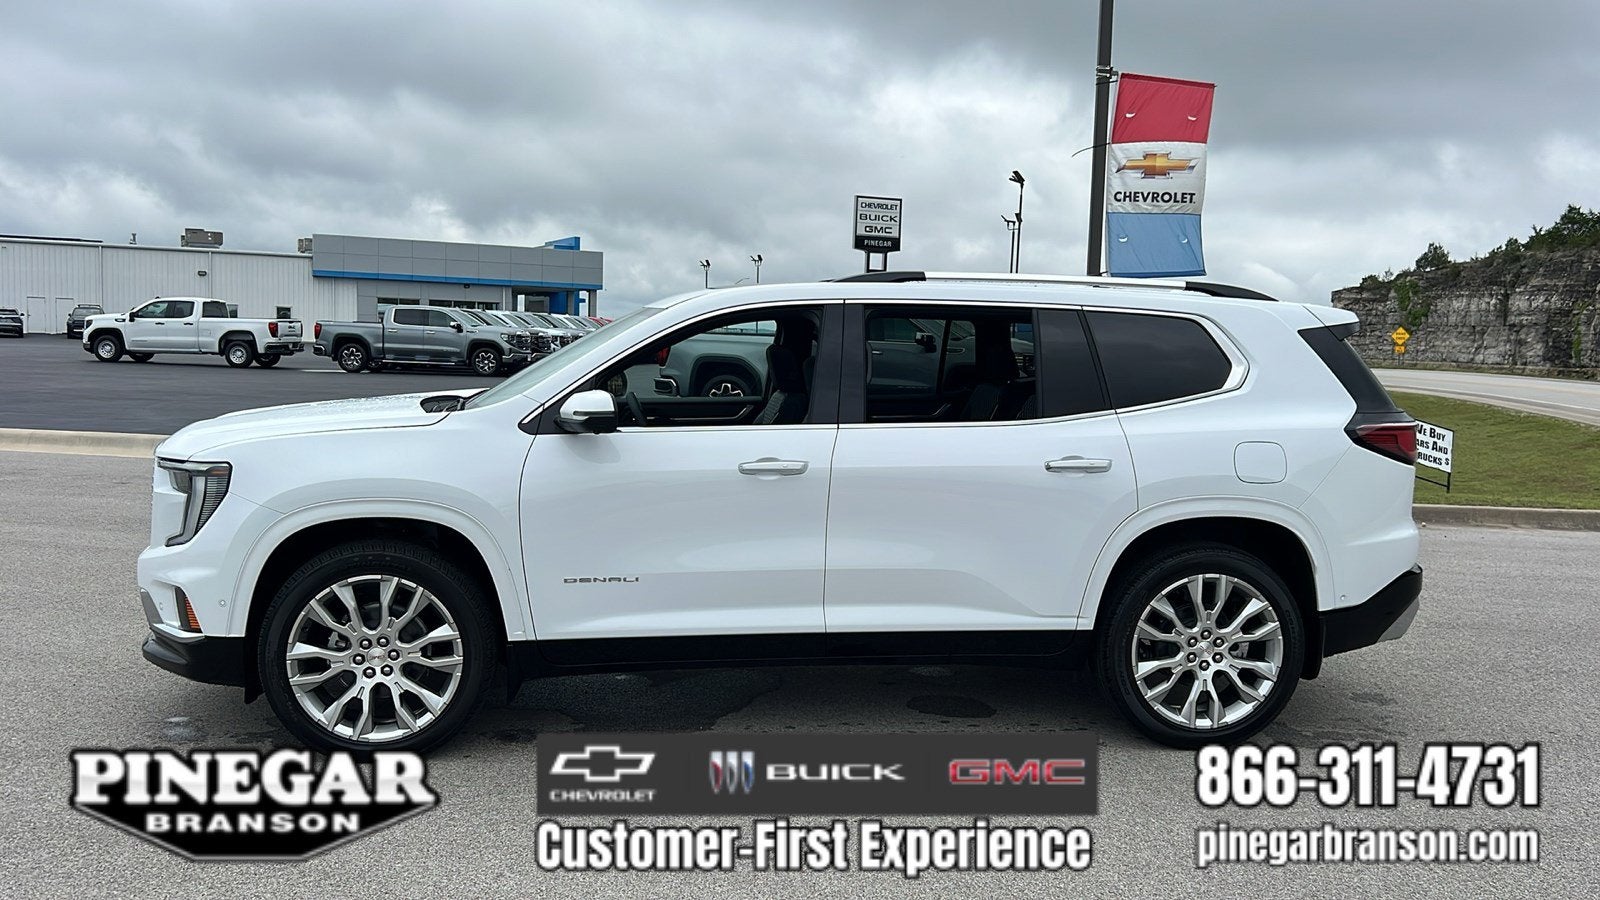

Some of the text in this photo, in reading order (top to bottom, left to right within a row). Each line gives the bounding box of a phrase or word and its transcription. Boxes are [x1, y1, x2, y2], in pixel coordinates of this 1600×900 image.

[1113, 190, 1196, 204] CHEVROLET
[860, 201, 898, 211] CHEVROLET
[859, 213, 898, 223] BUICK
[864, 225, 893, 235] GMC
[864, 239, 892, 247] PINEGAR
[1416, 439, 1430, 449] ARS
[1417, 450, 1442, 465] RUCKS
[563, 576, 640, 584] DENALI
